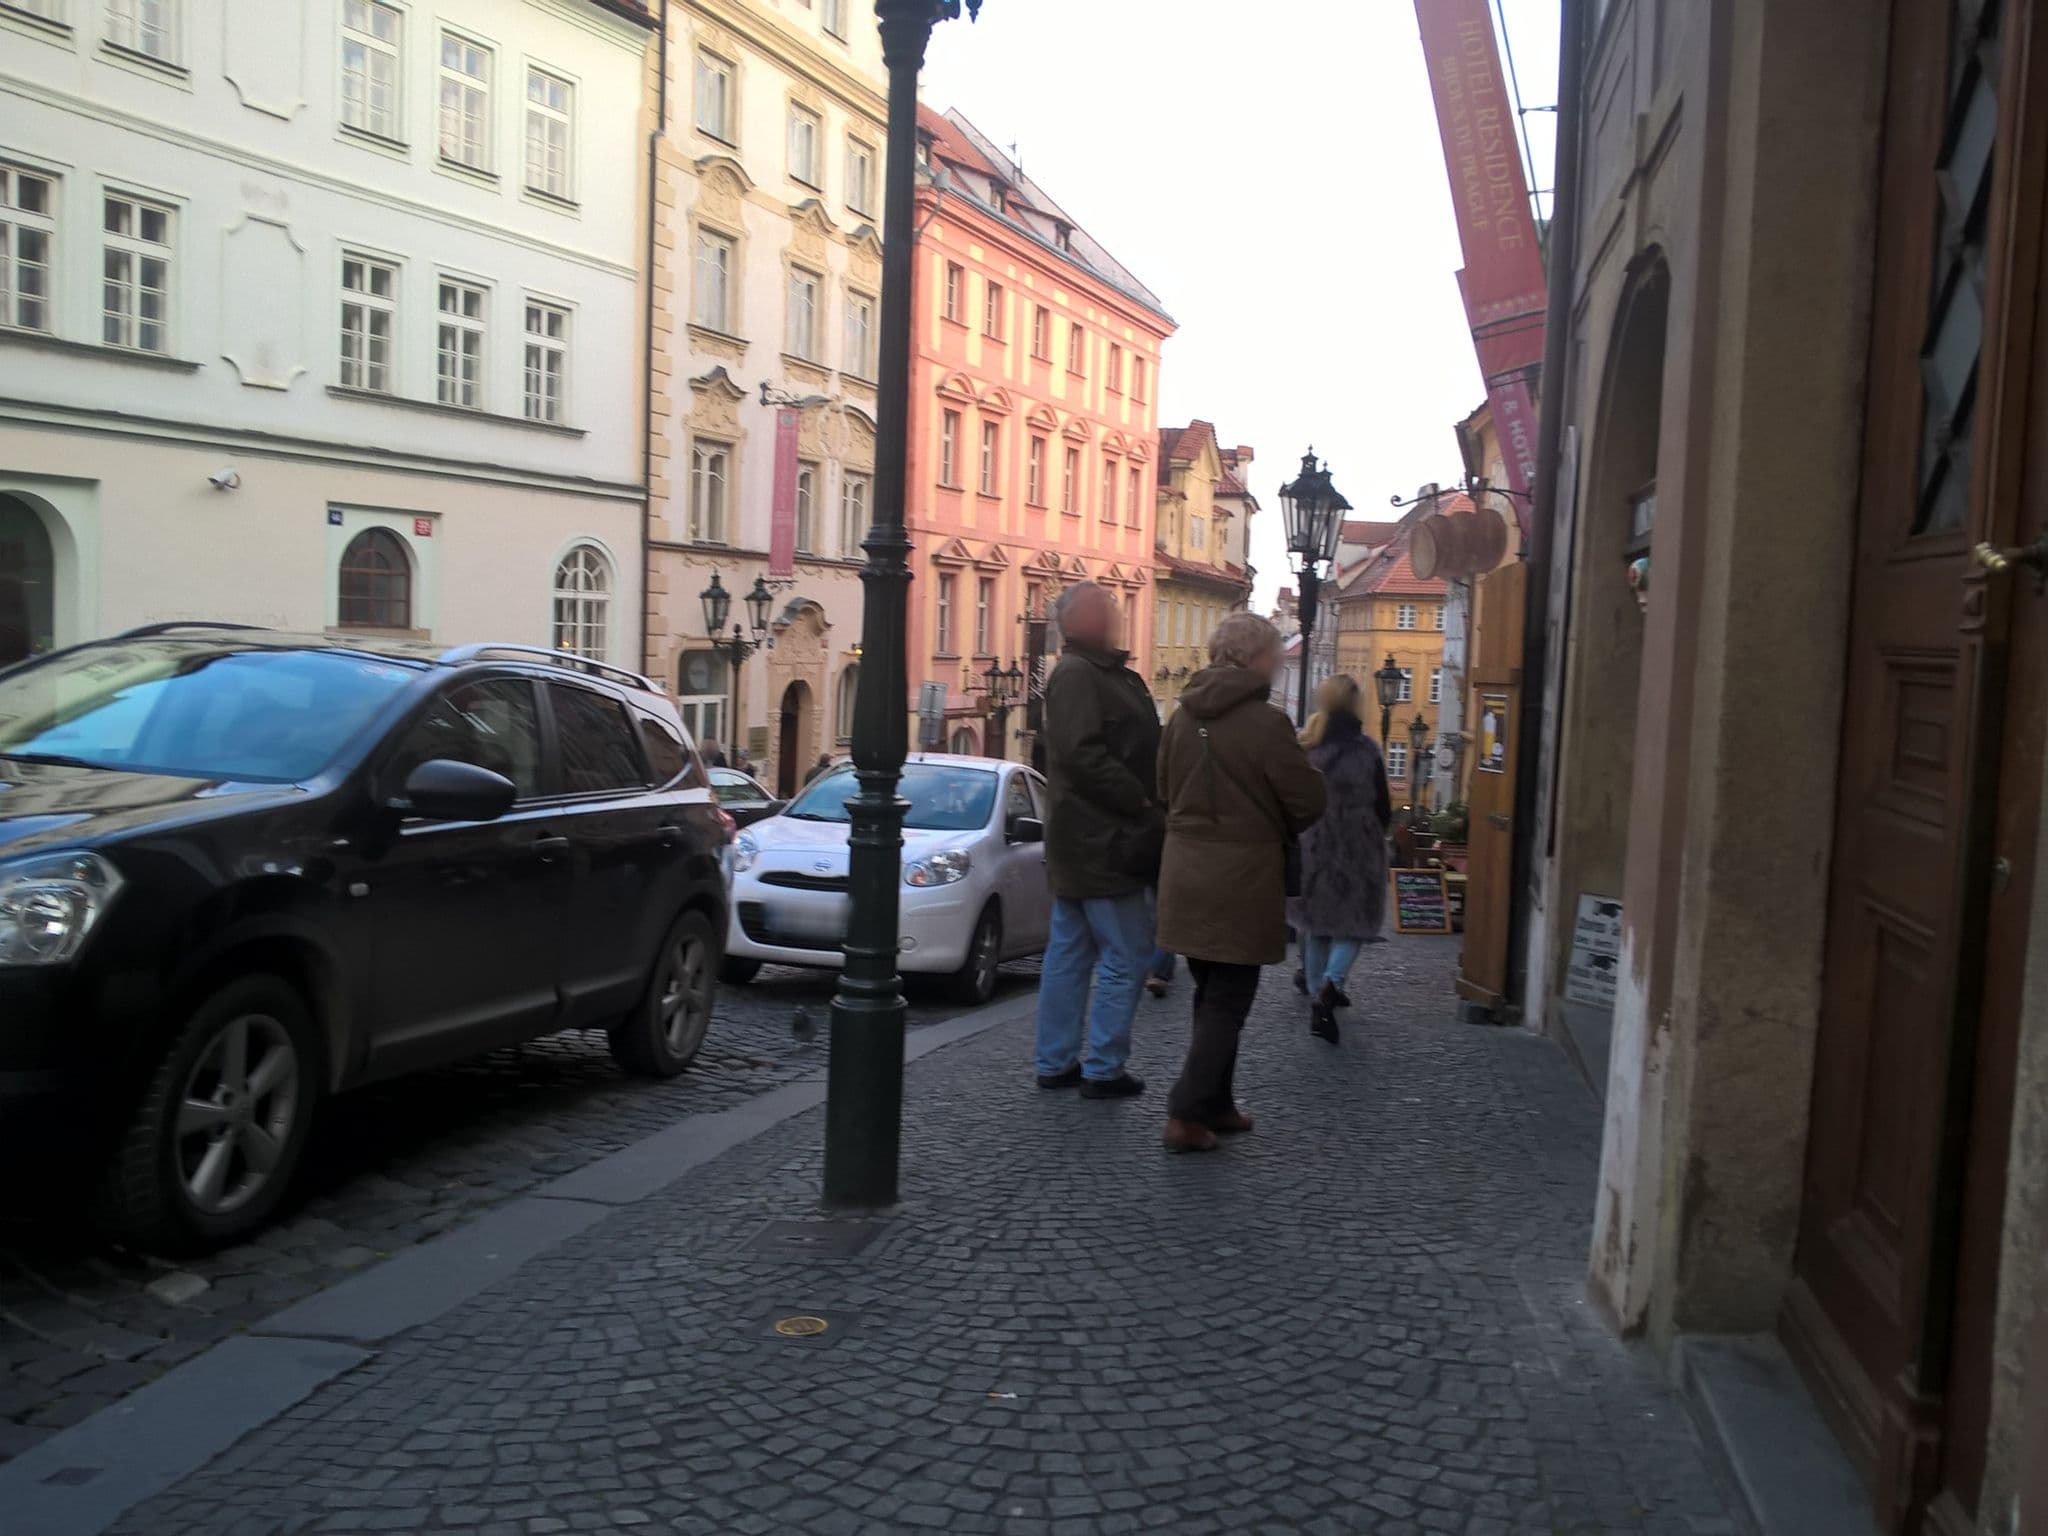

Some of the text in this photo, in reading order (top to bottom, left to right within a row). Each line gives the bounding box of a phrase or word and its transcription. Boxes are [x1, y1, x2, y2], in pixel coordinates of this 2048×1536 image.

[1457, 20, 1525, 250] HOTEL RESIDENCE
[1460, 153, 1489, 231] PRAGUE
